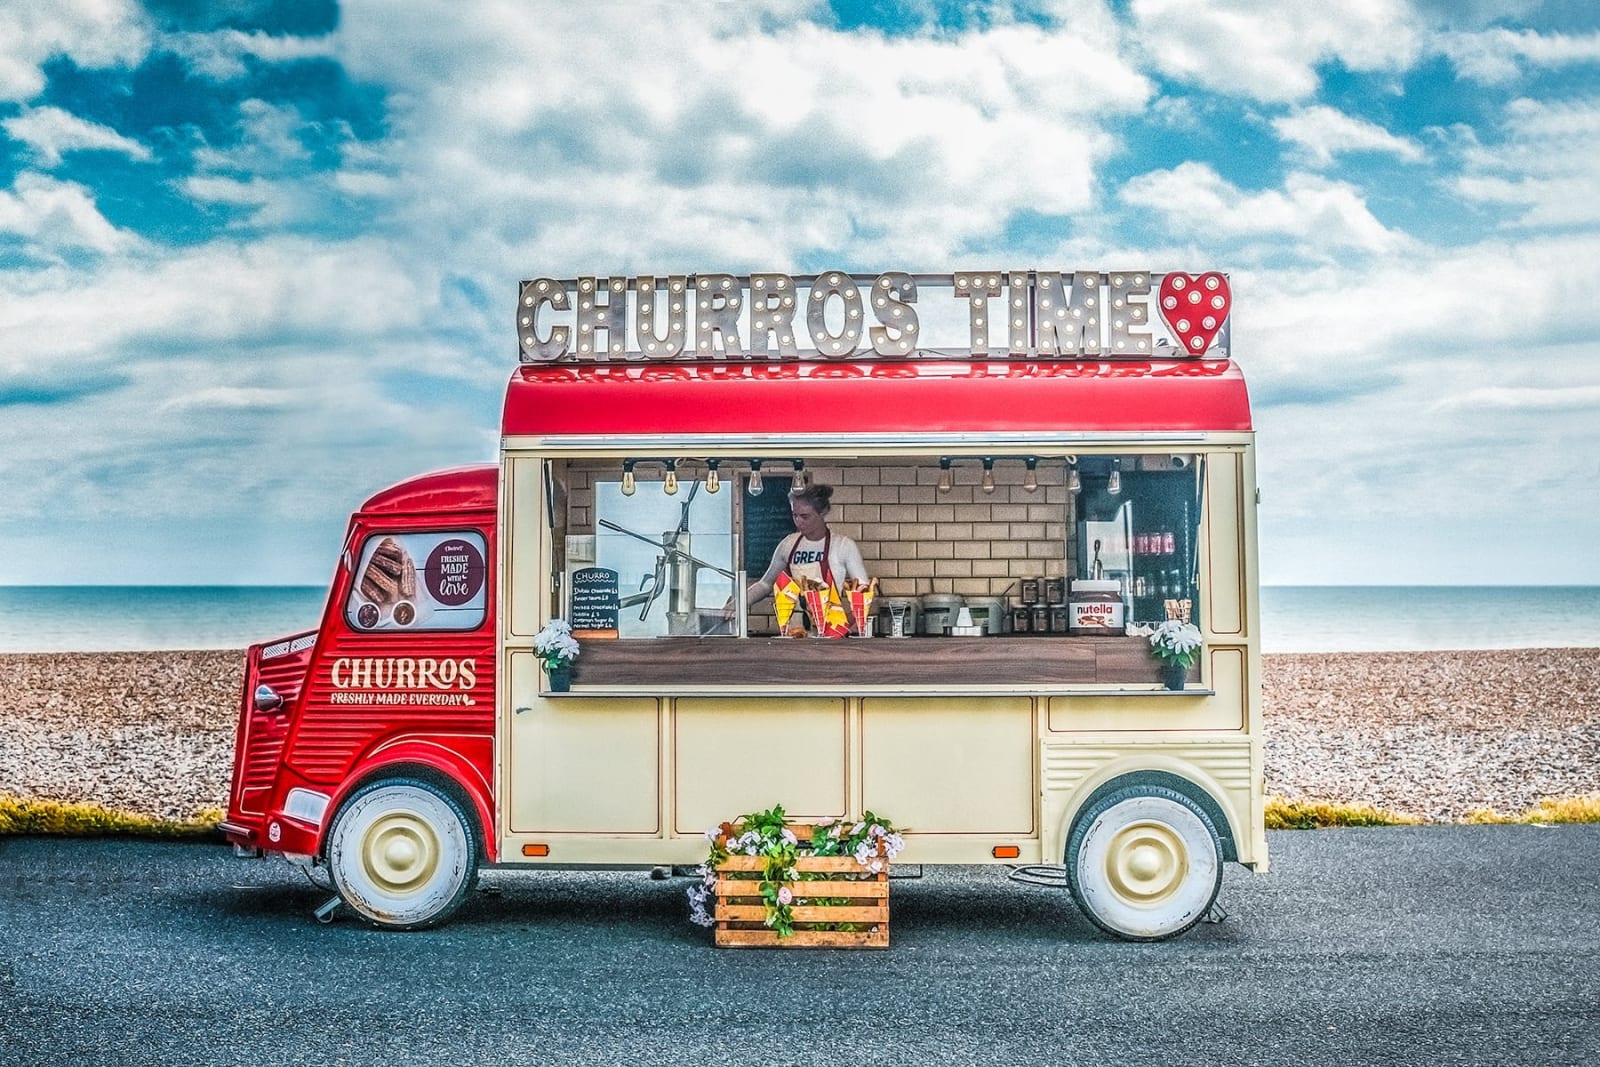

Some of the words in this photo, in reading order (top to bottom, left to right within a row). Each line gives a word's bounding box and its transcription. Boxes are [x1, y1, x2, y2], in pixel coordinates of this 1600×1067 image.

[516, 271, 919, 362] CHURROS
[954, 271, 1153, 359] TIME
[441, 555, 469, 563] FRESHLY
[440, 563, 469, 574] MADE
[439, 578, 469, 596] love
[1076, 604, 1113, 615] nutella
[331, 657, 477, 690] CHURROS
[330, 692, 375, 705] FRESHLY
[375, 693, 408, 705] MADE
[409, 693, 463, 706] EVERYDAY
